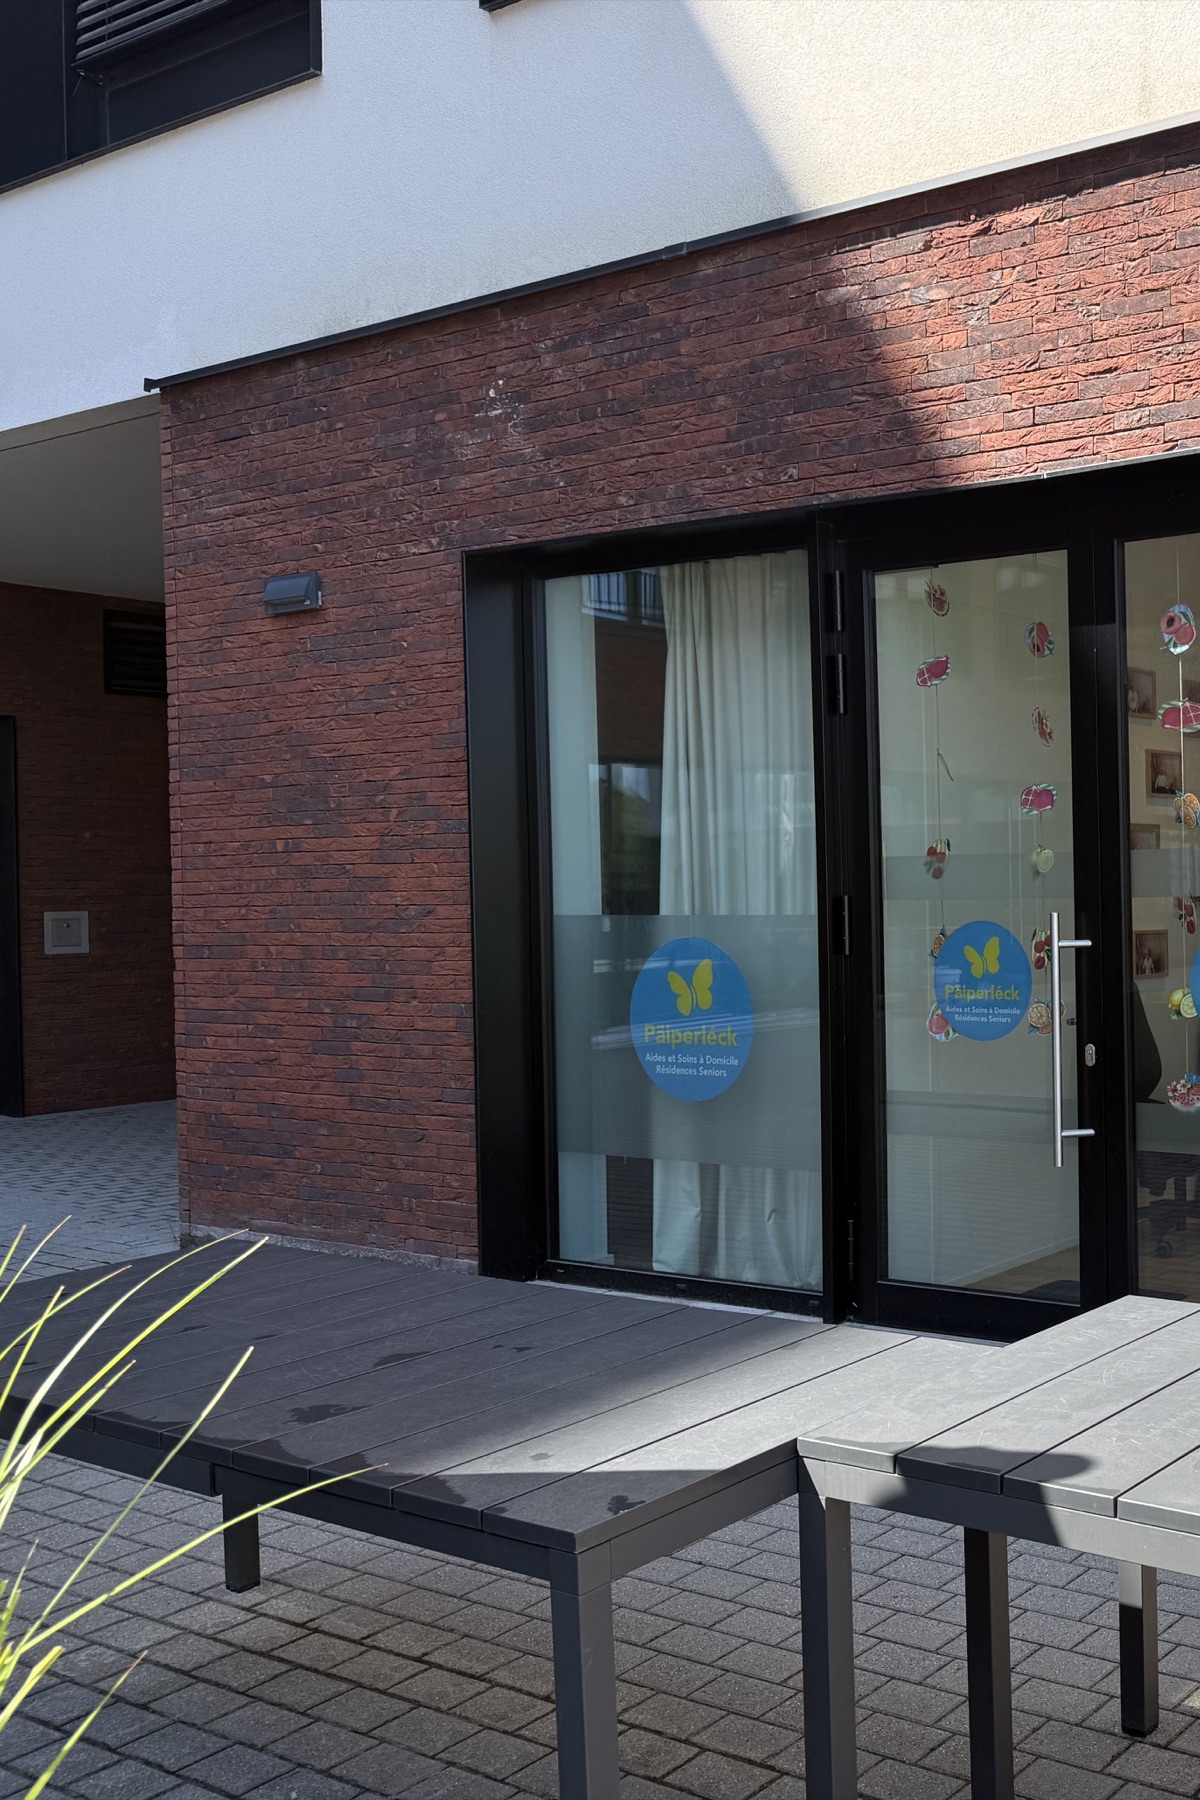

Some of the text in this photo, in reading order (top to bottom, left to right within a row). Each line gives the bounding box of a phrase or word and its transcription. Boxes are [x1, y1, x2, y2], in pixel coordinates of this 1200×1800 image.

[945, 984, 1019, 1003] Päiperléck
[644, 1024, 737, 1049] Päiperléck
[645, 1053, 739, 1066] Aides et Soins à Domicile
[656, 1065, 726, 1077] Résidences Seniors
